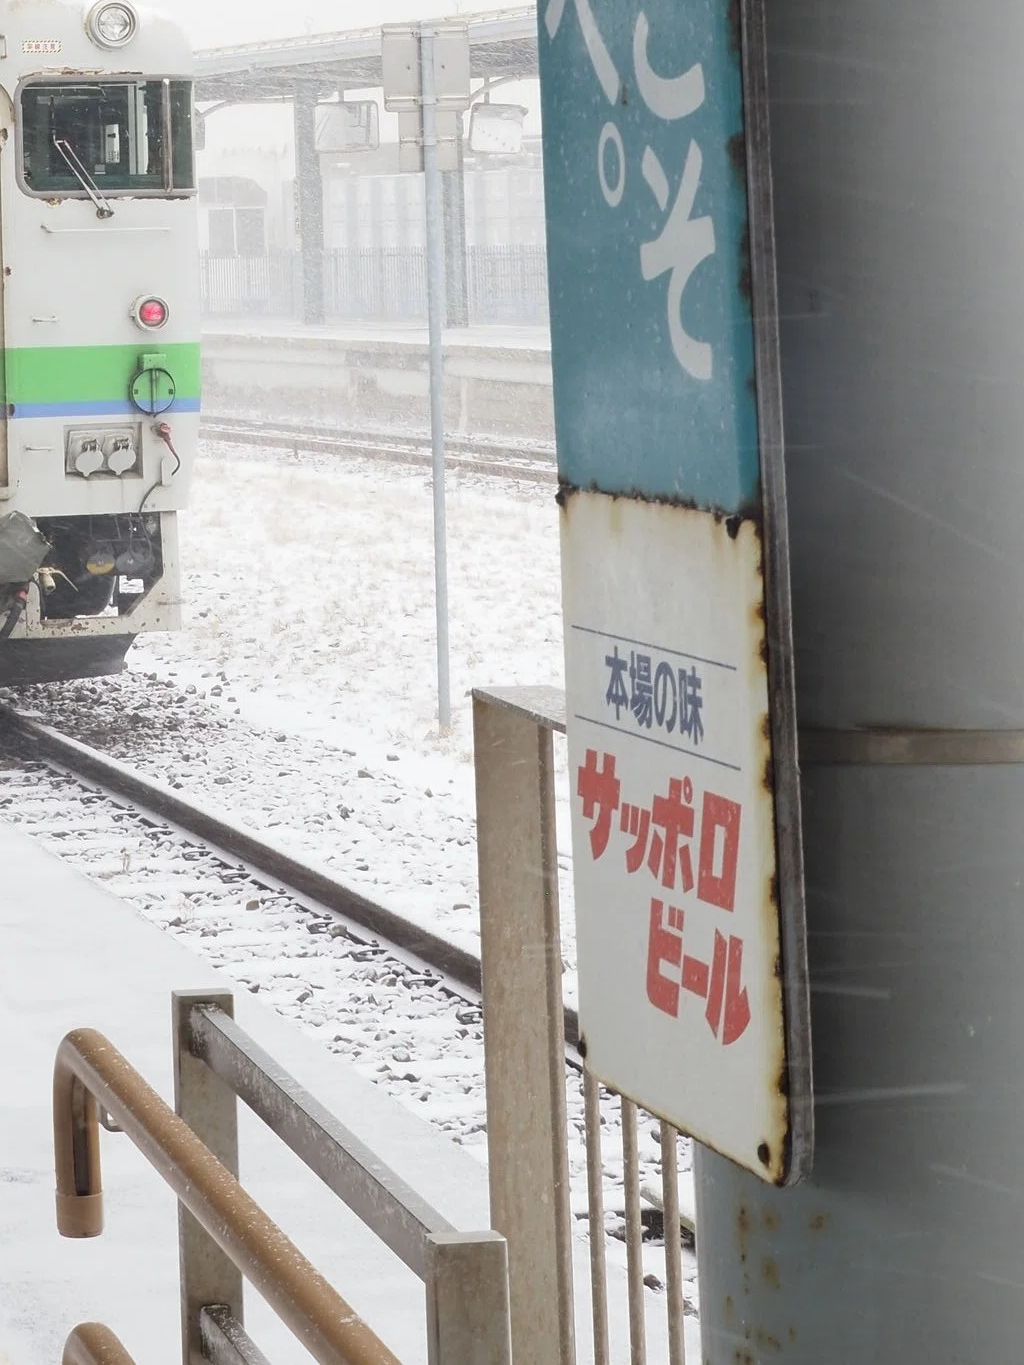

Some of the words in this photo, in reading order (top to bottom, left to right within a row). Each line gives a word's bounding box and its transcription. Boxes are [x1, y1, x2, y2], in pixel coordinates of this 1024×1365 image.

[604, 645, 704, 745] 本場の味
[577, 748, 742, 913] サッポロ
[646, 896, 751, 1047] ビール
